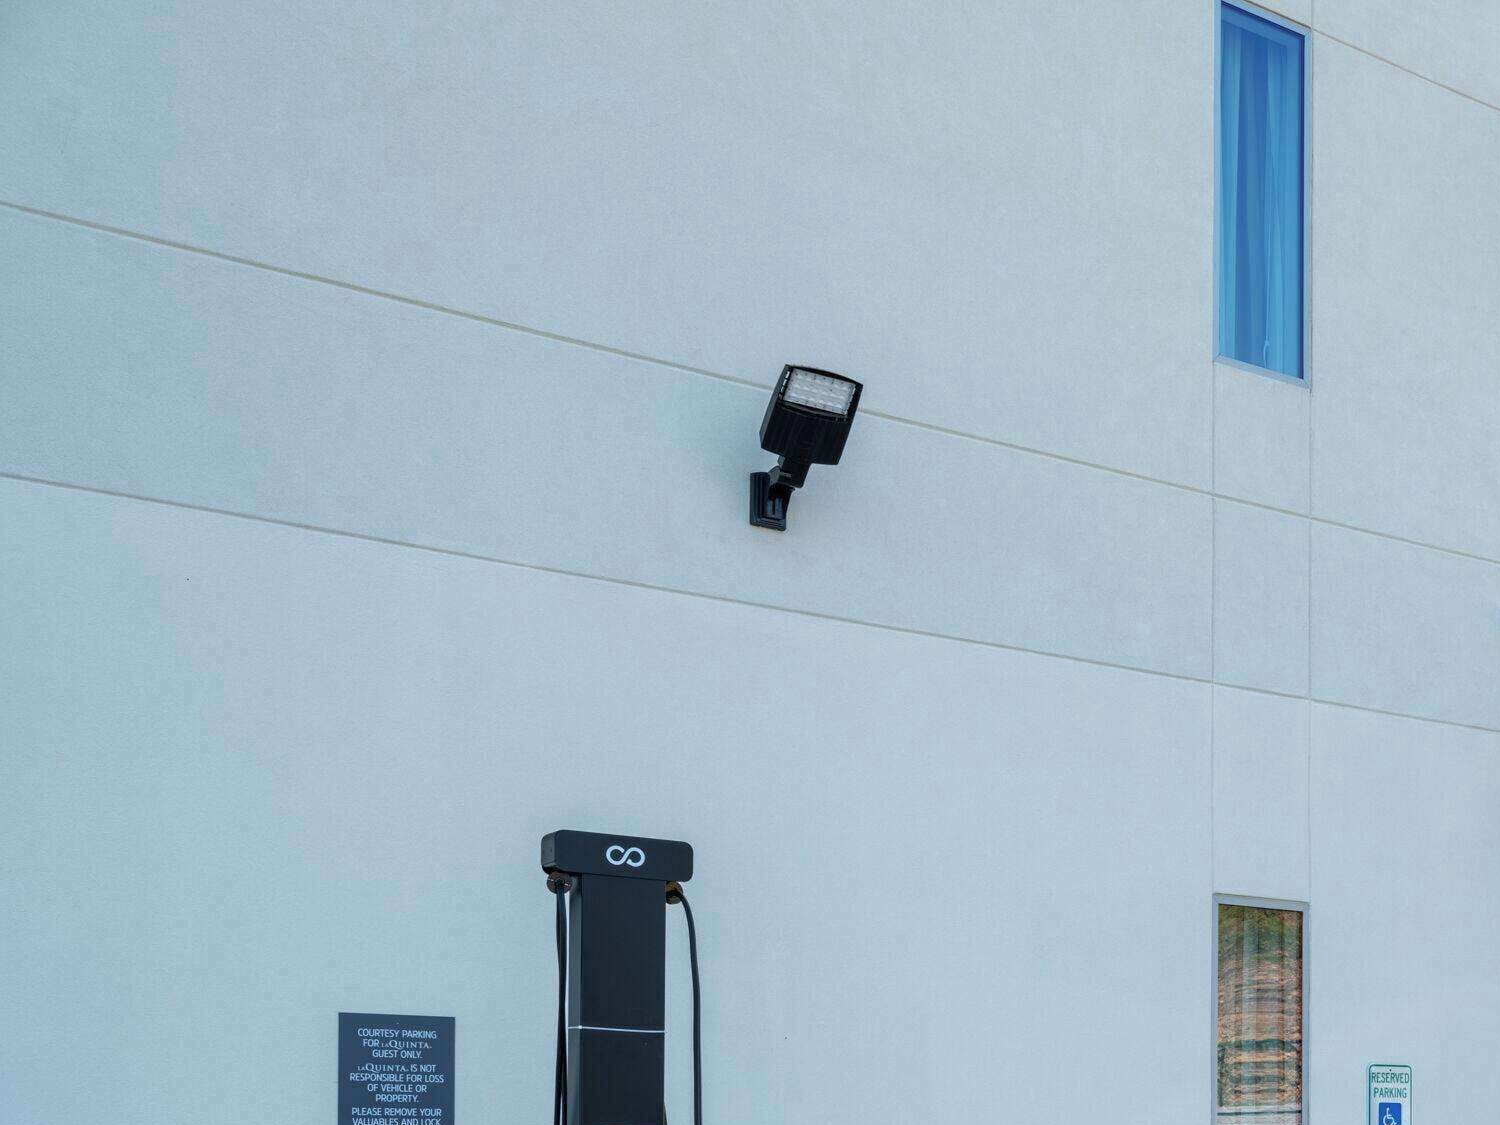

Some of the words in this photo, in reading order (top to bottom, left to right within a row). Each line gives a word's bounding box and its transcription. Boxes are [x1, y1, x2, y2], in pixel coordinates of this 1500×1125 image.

[357, 1028, 400, 1038] COURTESY
[402, 1029, 437, 1039] PARKING
[362, 1039, 379, 1047] FOR
[372, 1049, 398, 1058] GUEST
[400, 1050, 423, 1059] ONLY.
[410, 1064, 418, 1072] IS
[420, 1064, 436, 1073] NOT
[350, 1073, 404, 1082] RESPONSIBLE
[406, 1074, 422, 1083] FOR
[425, 1074, 444, 1083] LOSS
[1371, 1072, 1409, 1084] RESERVED
[367, 1083, 379, 1092] OF
[381, 1084, 413, 1093] VEHICLE
[415, 1084, 427, 1093] OR
[1373, 1087, 1407, 1099] PARKING
[375, 1094, 419, 1103] PROPERTY.
[352, 1107, 382, 1116] PLEASE
[384, 1107, 418, 1116] REMOVE
[420, 1108, 442, 1117] YOUR
[401, 1118, 419, 1125] AND
